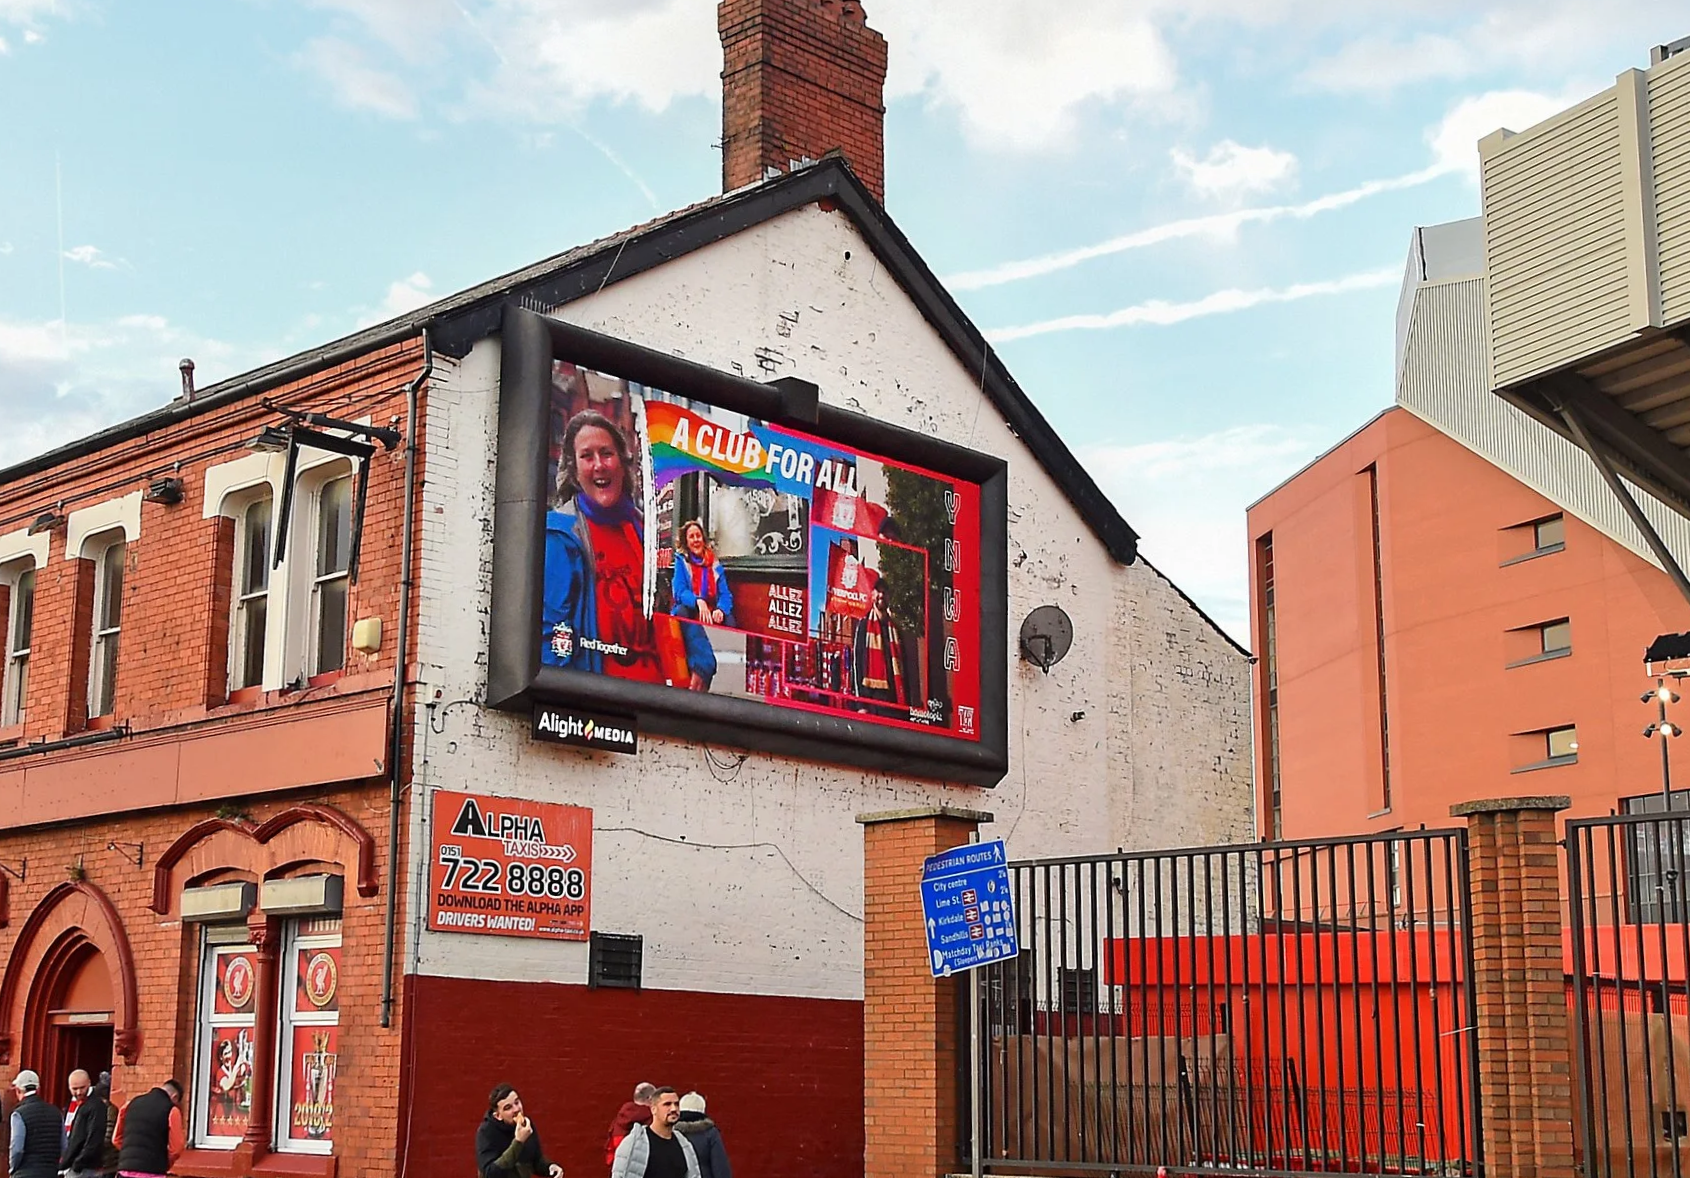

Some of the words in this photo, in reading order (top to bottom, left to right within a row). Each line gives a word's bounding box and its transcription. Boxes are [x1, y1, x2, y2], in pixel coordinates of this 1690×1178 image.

[670, 417, 689, 450] A
[696, 424, 761, 469] CLUB
[764, 443, 815, 484] FOR
[815, 459, 858, 497] ALL
[768, 583, 803, 603] ALLEZ
[768, 599, 803, 618] ALLEZ
[768, 615, 803, 634] ALLEZ
[538, 711, 584, 738] Alight
[594, 726, 634, 744] MEDIA
[452, 799, 545, 842] ALPHA
[440, 846, 461, 857] 0151
[504, 840, 541, 857] TAXIS
[926, 856, 966, 872] PEDESTRIAN
[966, 851, 993, 864] ROUTES
[440, 858, 501, 893] 722
[507, 863, 584, 899] 8888
[933, 882, 947, 892] City
[947, 879, 968, 889] centre
[437, 894, 501, 911] DOWNLOAD
[504, 899, 524, 913] THE
[527, 901, 561, 915] ALPHA
[563, 904, 584, 917] APP
[935, 899, 951, 909] Lime
[437, 911, 486, 927] DRIVERS
[486, 915, 536, 931] WANTED!
[938, 913, 964, 926] Kirkdale
[940, 930, 969, 944] Sandhills
[941, 946, 971, 960] Matchday
